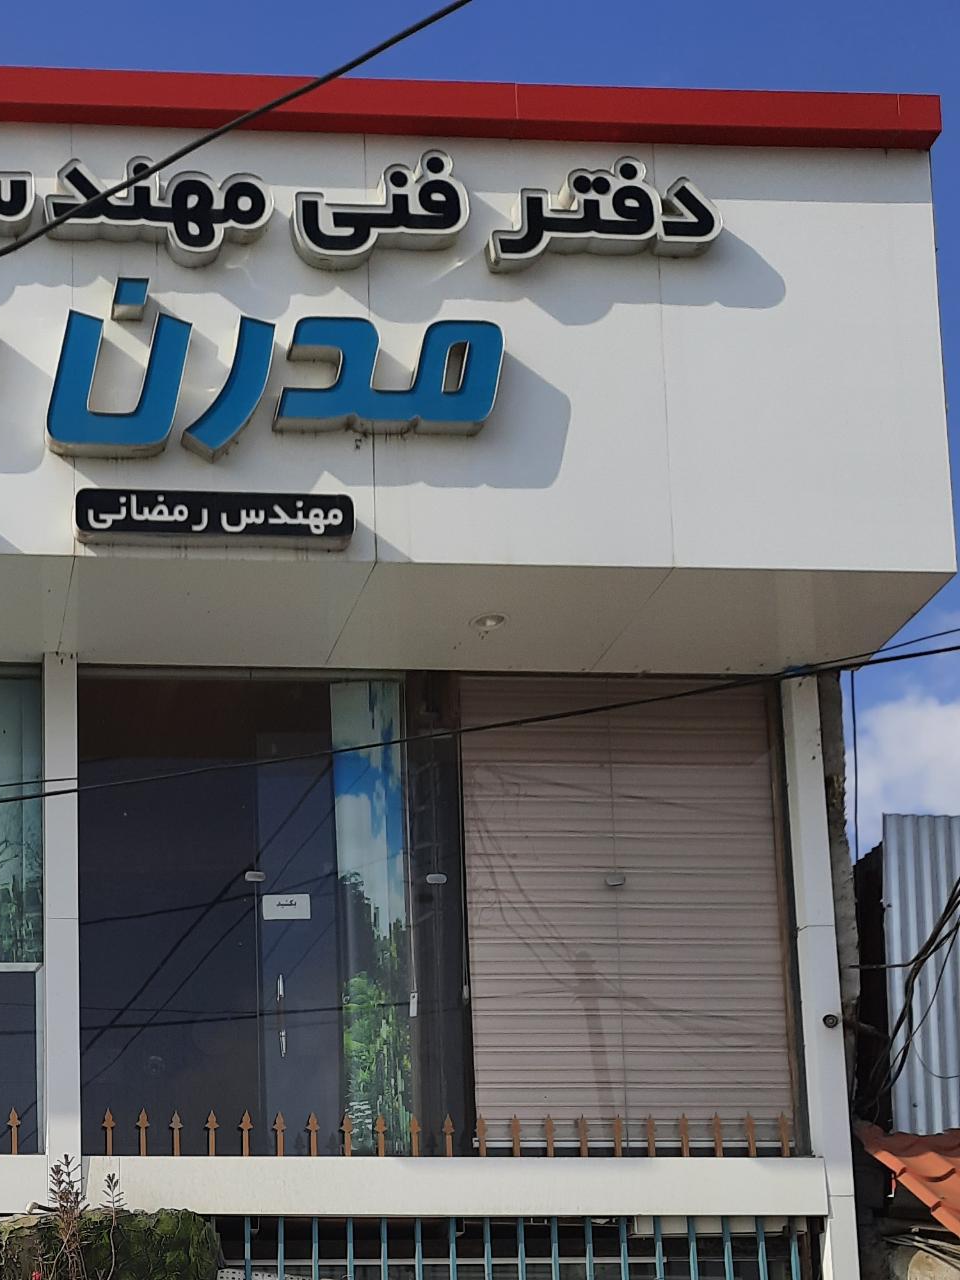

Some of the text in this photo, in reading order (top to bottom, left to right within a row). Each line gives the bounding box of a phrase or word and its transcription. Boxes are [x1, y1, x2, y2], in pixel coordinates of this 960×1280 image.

[296, 151, 467, 263] فنی
[495, 157, 722, 262] دفتر
[46, 277, 505, 453] مدرن
[87, 494, 344, 536] مهندس رمضانی
